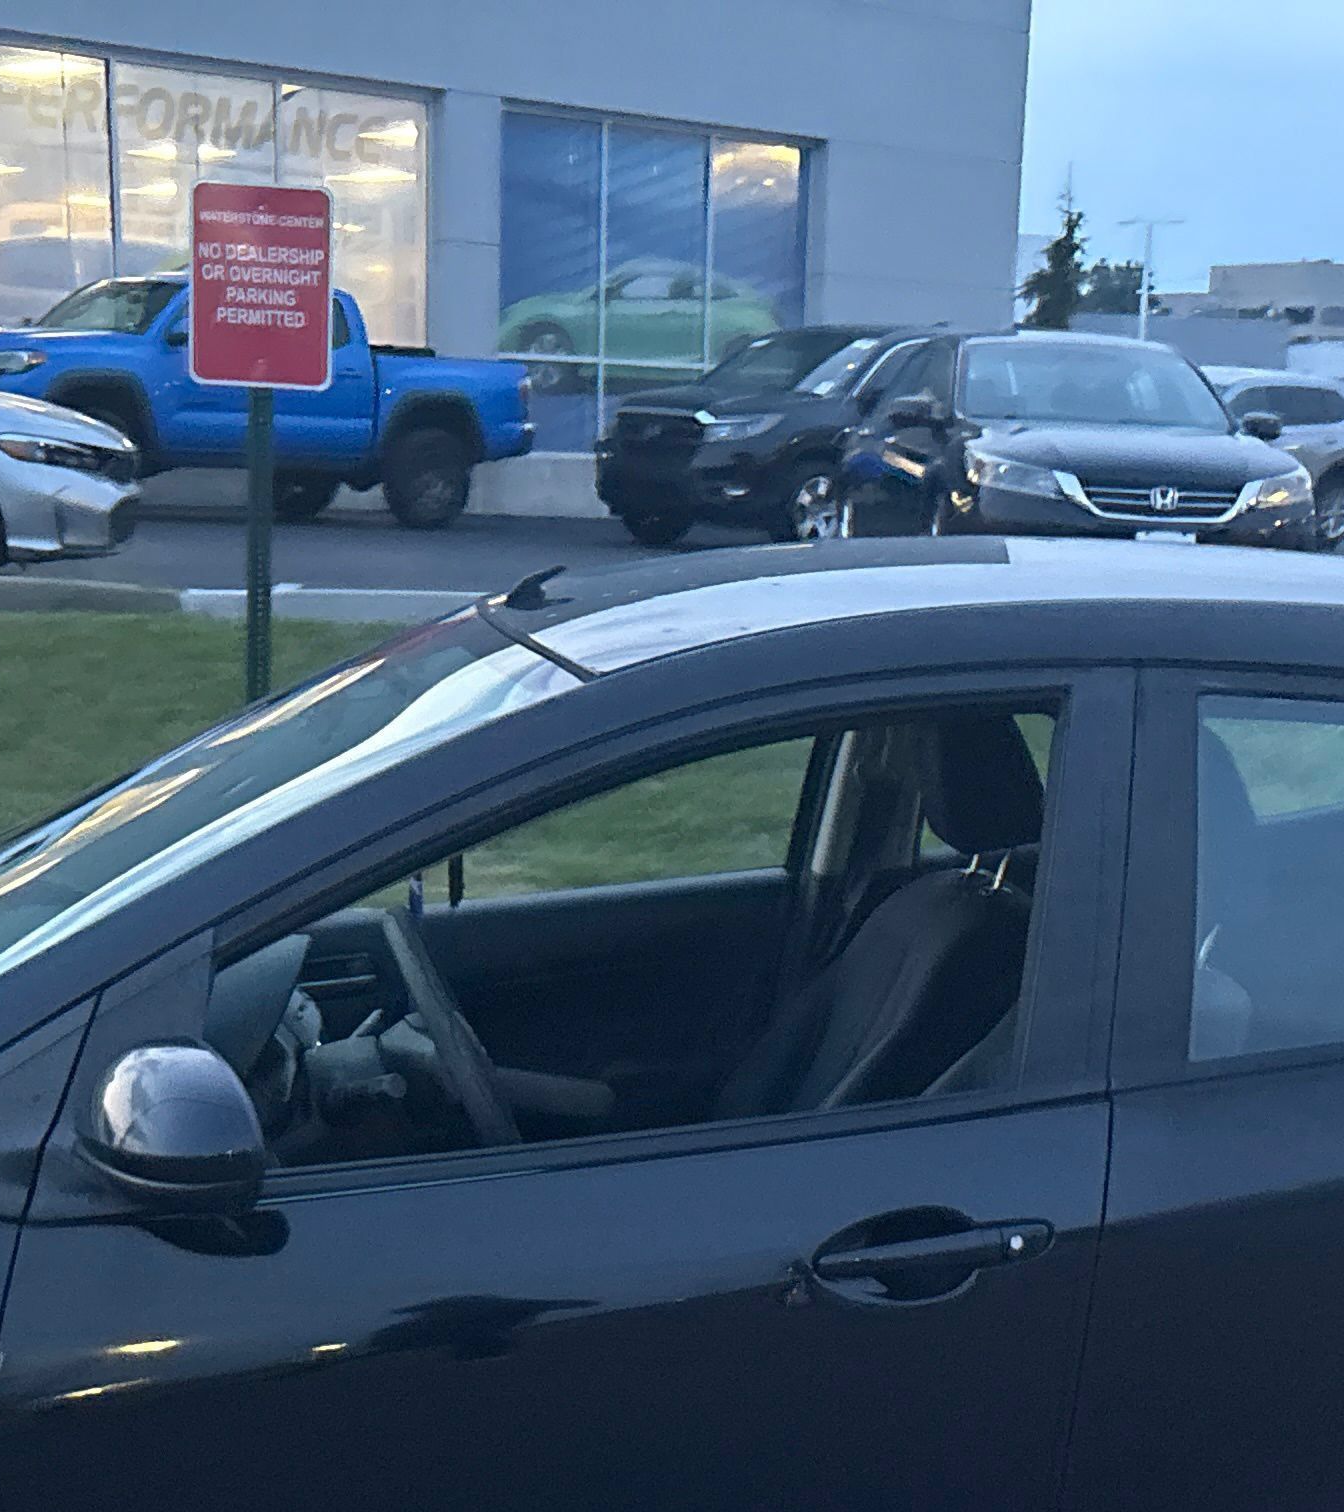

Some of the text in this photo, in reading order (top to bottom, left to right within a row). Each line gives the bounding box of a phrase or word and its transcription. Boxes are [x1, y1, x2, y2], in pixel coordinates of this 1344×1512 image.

[279, 215, 324, 229] CENTER
[198, 243, 324, 264] NO DEALERSHIP
[202, 263, 321, 286] OR OVERNIGHT
[226, 287, 296, 306] PARKING
[216, 307, 305, 328] PERMITTED
